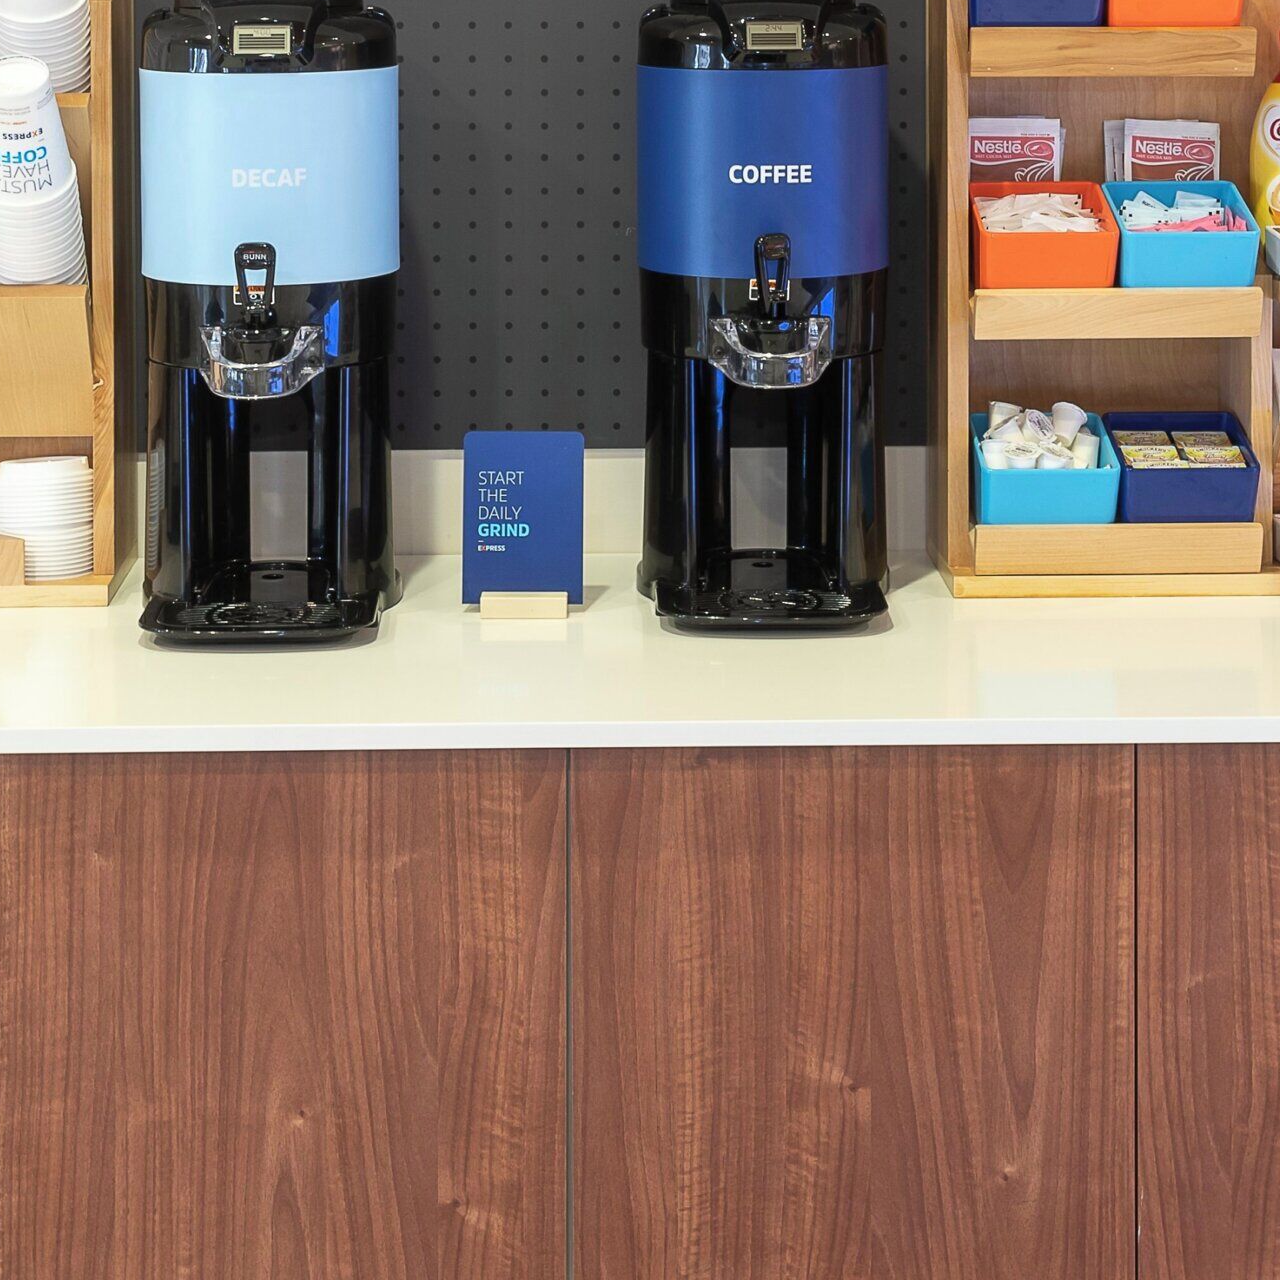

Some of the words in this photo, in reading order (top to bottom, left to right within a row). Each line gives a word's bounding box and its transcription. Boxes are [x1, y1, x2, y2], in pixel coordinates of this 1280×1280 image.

[2, 127, 43, 141] EXPRESS
[0, 159, 50, 179] HAVE.
[728, 164, 813, 184] COFFEE
[231, 167, 307, 188] DECAF
[478, 470, 525, 486] START
[478, 488, 508, 503] THE
[478, 505, 522, 520] DAILY
[477, 523, 530, 538] GRIND
[477, 544, 506, 552] EXPRESS
